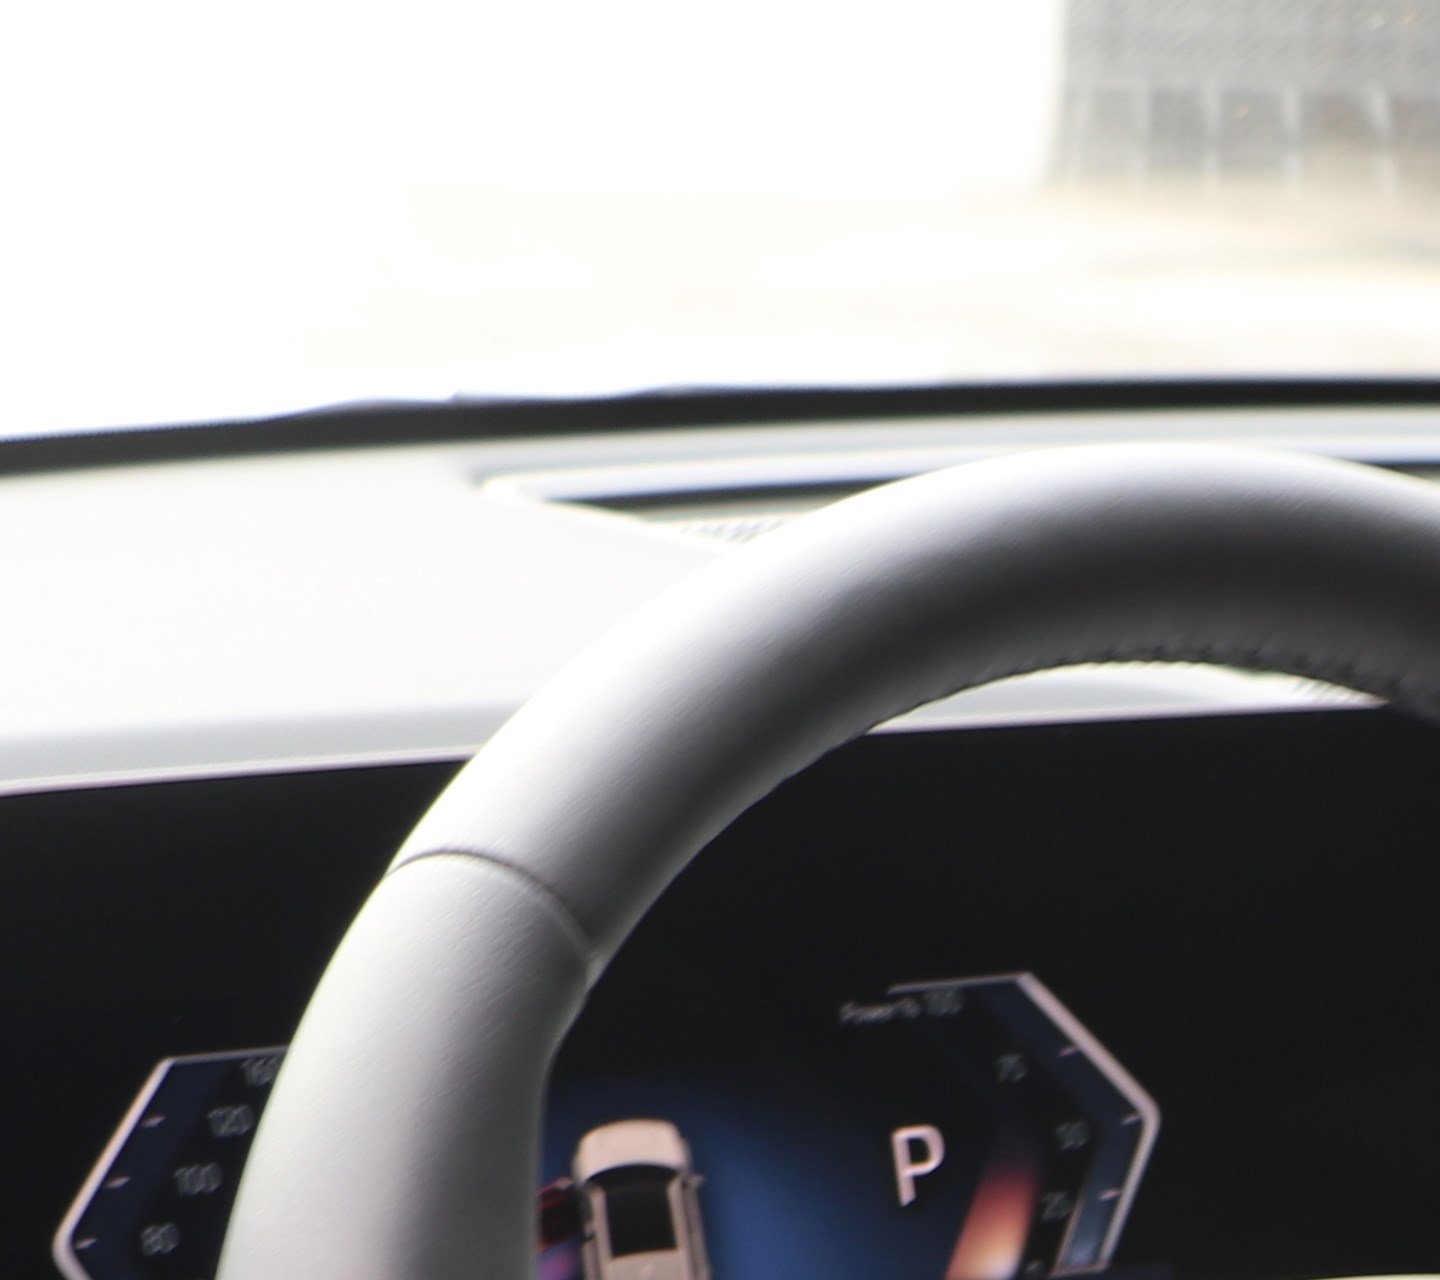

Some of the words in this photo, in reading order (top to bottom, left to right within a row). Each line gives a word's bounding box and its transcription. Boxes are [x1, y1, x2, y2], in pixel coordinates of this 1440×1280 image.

[174, 1162, 222, 1195] 100
[891, 1124, 946, 1207] P
[141, 1223, 180, 1255] 80
